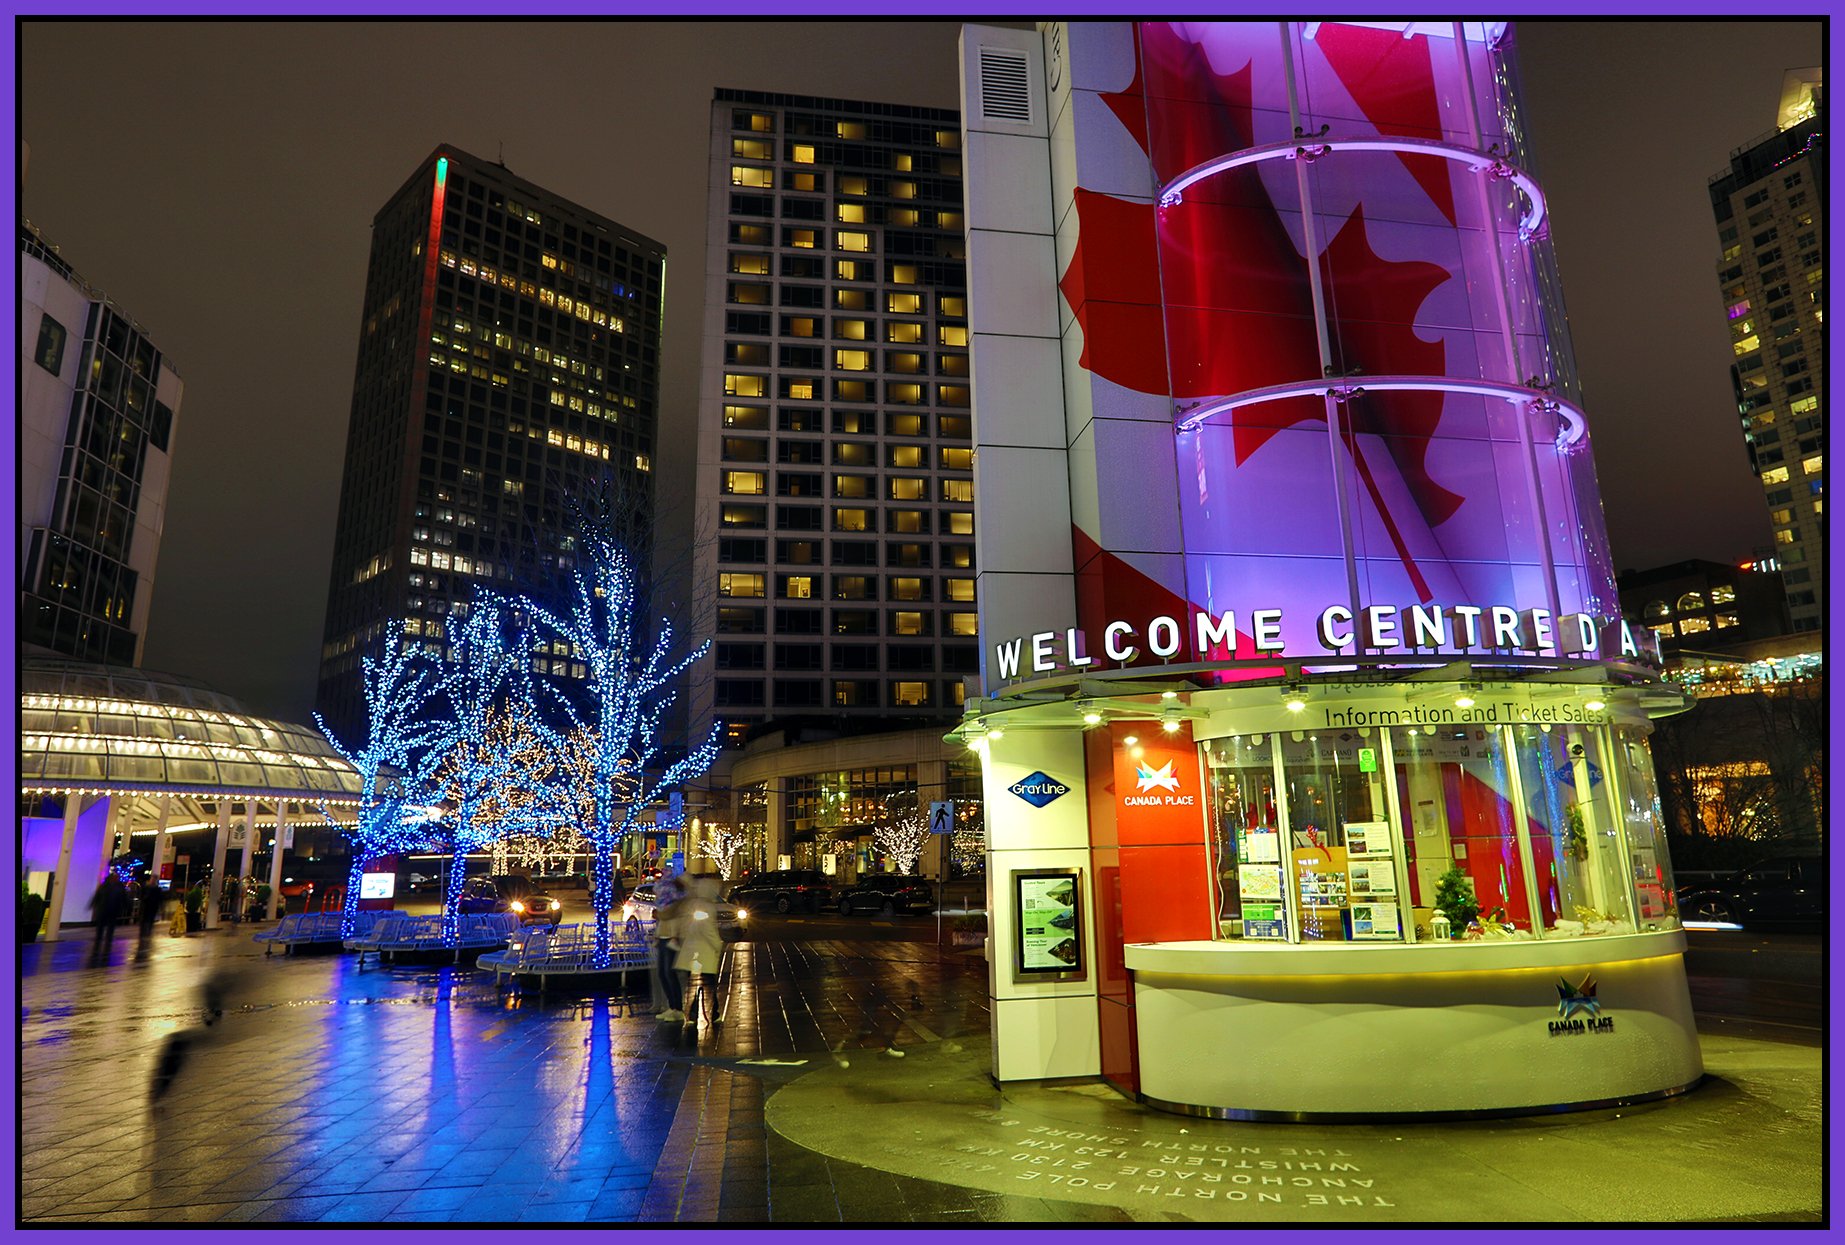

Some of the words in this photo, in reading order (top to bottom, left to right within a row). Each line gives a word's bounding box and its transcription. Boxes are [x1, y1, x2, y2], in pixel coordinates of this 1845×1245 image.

[996, 608, 1285, 680] WELCOME
[1320, 605, 1555, 648] CENTRE
[1325, 704, 1454, 727] Information
[1462, 703, 1497, 723] and
[1502, 702, 1558, 722] Ticket
[1562, 703, 1604, 723] Sales
[1124, 796, 1162, 806] CANADA
[1165, 795, 1194, 805] PLACE
[1548, 1019, 1585, 1032] CANADA
[1587, 1017, 1614, 1029] PLACE
[1026, 1125, 1130, 1146] SHORE
[1018, 1138, 1068, 1151] KM
[1074, 1146, 1128, 1160] 123
[1142, 1140, 1261, 1155] NORTH
[1278, 1147, 1354, 1158] THE
[1010, 1153, 1092, 1170] 2130
[1158, 1154, 1362, 1173] WHISTLER
[1016, 1170, 1117, 1191] POLE
[1118, 1165, 1375, 1189] ANCHORAGE
[1135, 1183, 1282, 1204] NORTH
[1305, 1193, 1396, 1208] THE
